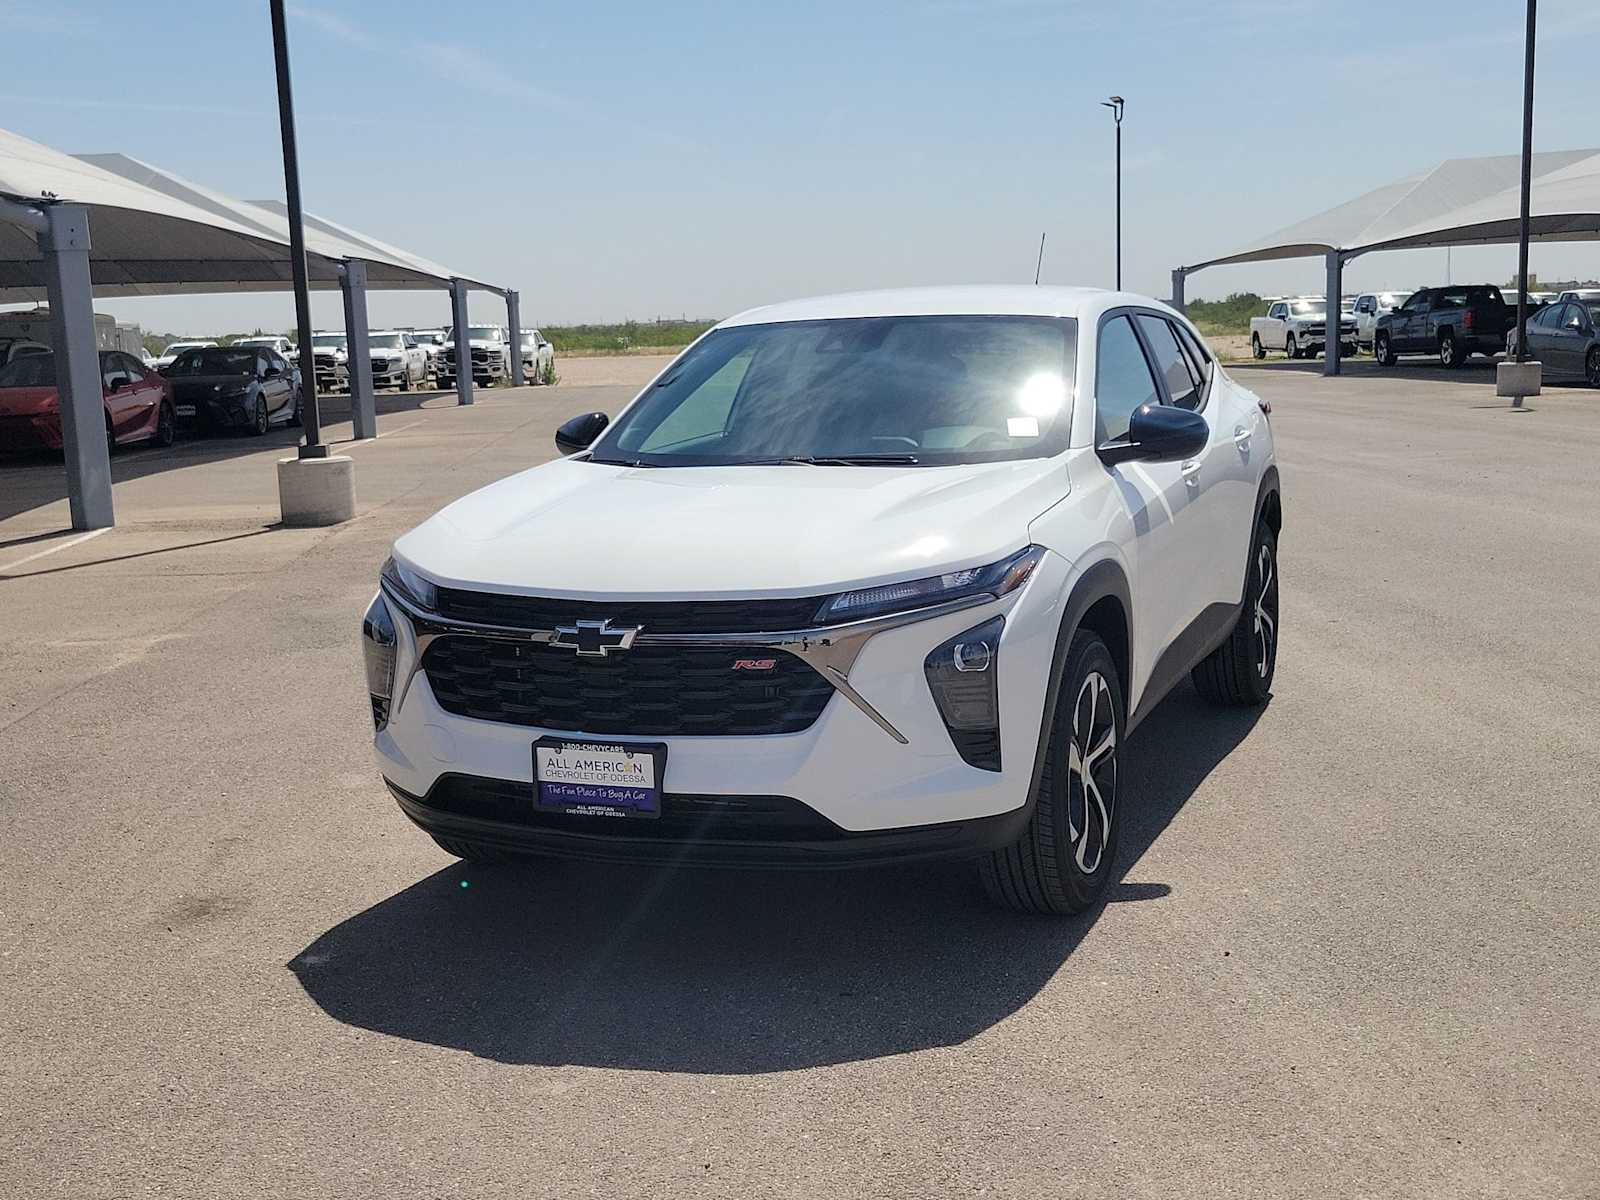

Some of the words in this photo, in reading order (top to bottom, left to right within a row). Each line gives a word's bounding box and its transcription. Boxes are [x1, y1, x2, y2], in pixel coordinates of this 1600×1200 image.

[732, 659, 776, 669] RS
[547, 758, 571, 769] ALL
[574, 760, 642, 774] AMERICN
[546, 770, 594, 780] CHEVROLET
[596, 773, 607, 781] OF
[610, 773, 646, 783] ODESSA
[547, 785, 561, 795] The
[561, 785, 575, 795] Fun
[576, 787, 596, 797] Place
[596, 788, 606, 798] To
[608, 790, 624, 801] Buy
[624, 791, 632, 799] A
